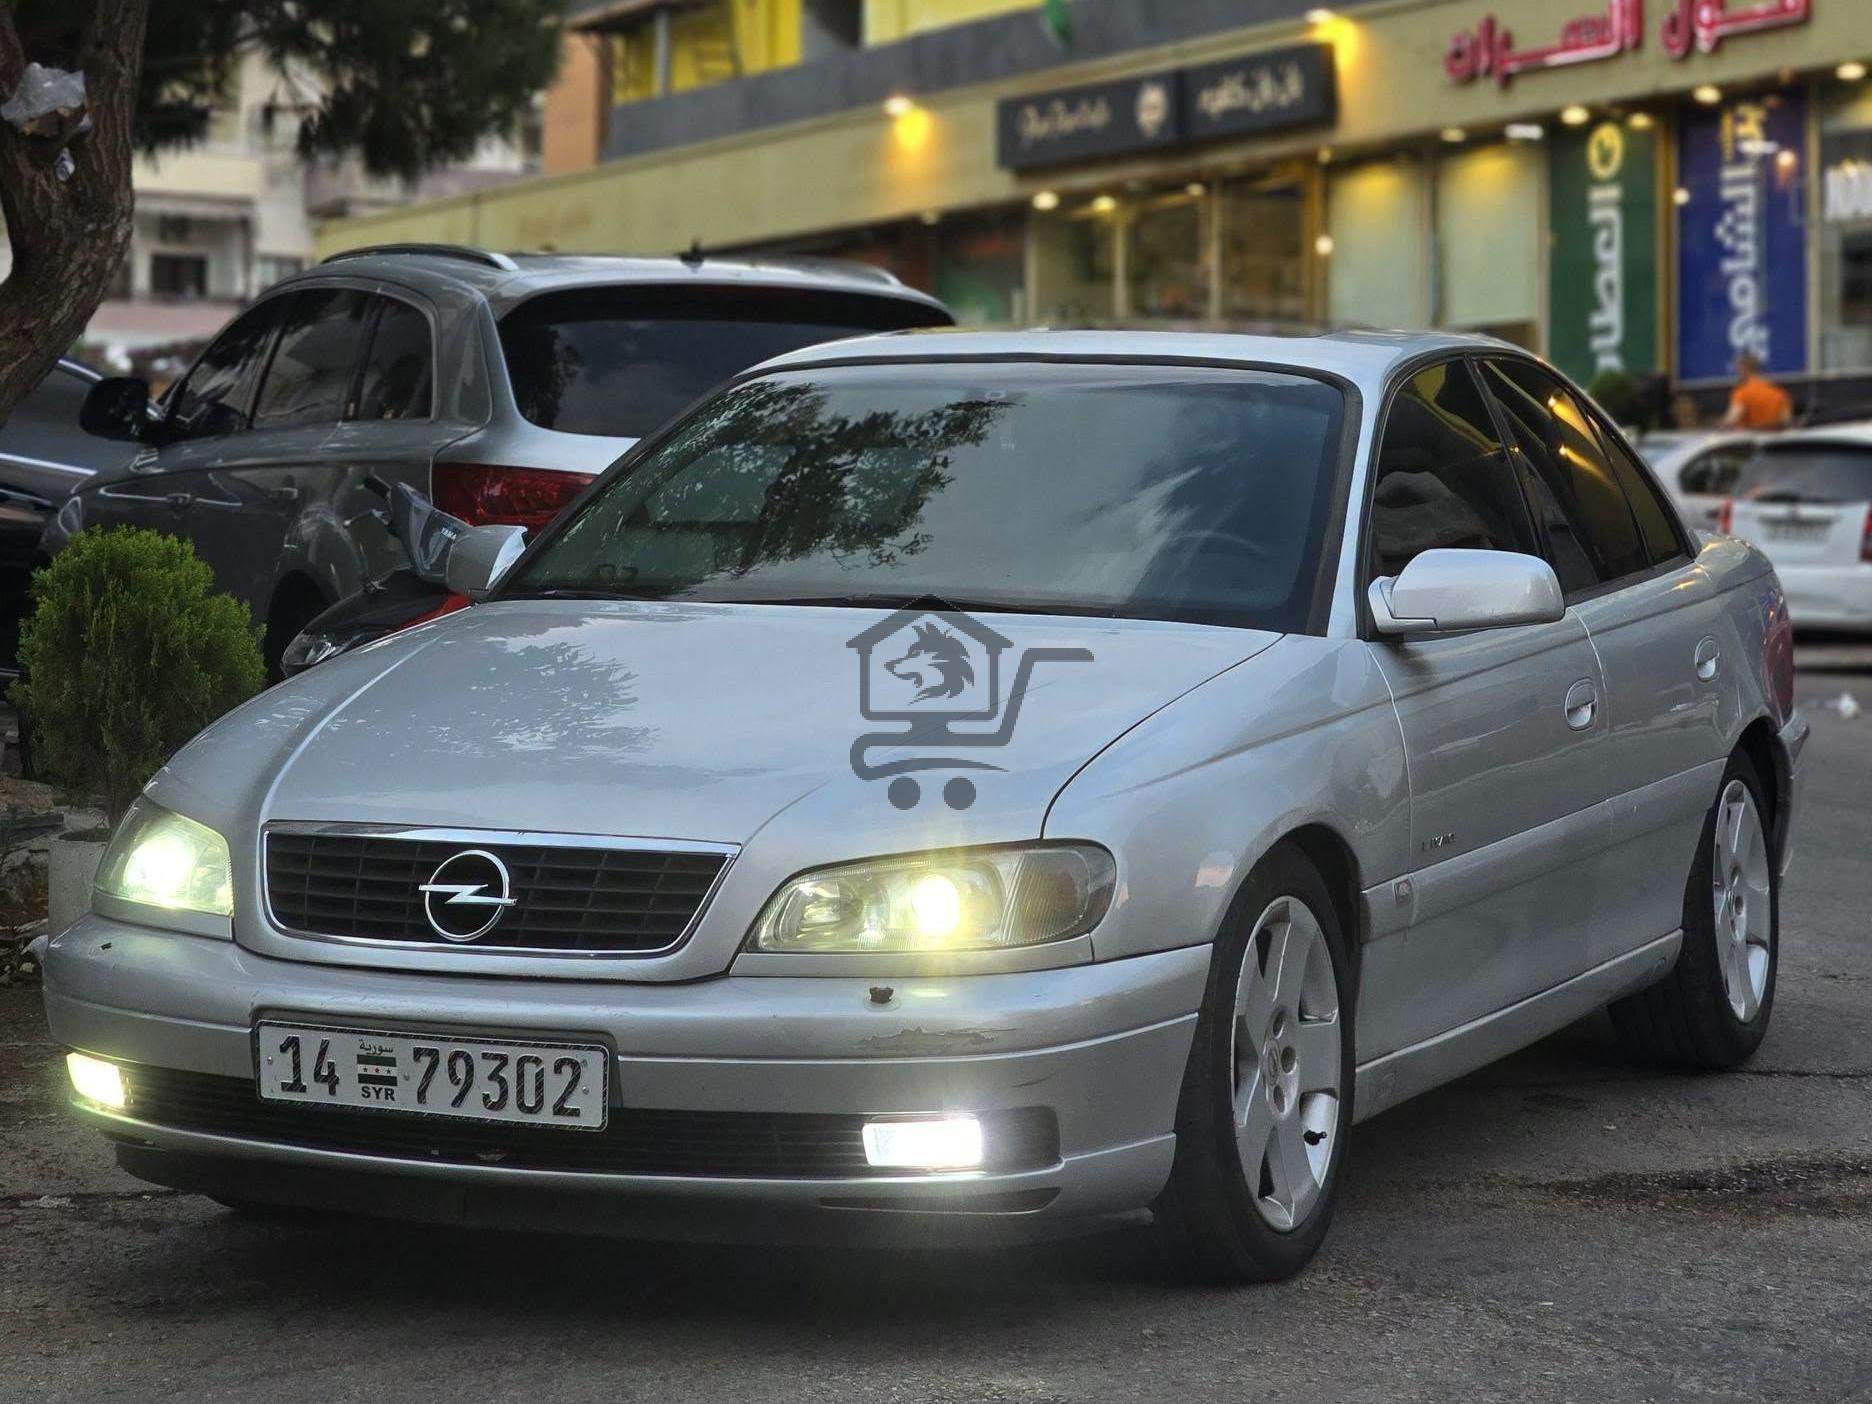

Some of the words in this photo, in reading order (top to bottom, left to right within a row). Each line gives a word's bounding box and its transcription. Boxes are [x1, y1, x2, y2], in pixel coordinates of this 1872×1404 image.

[359, 1038, 394, 1055] سورية
[279, 1035, 340, 1096] 14
[412, 1046, 582, 1117] 79302
[361, 1086, 396, 1101] SYR
